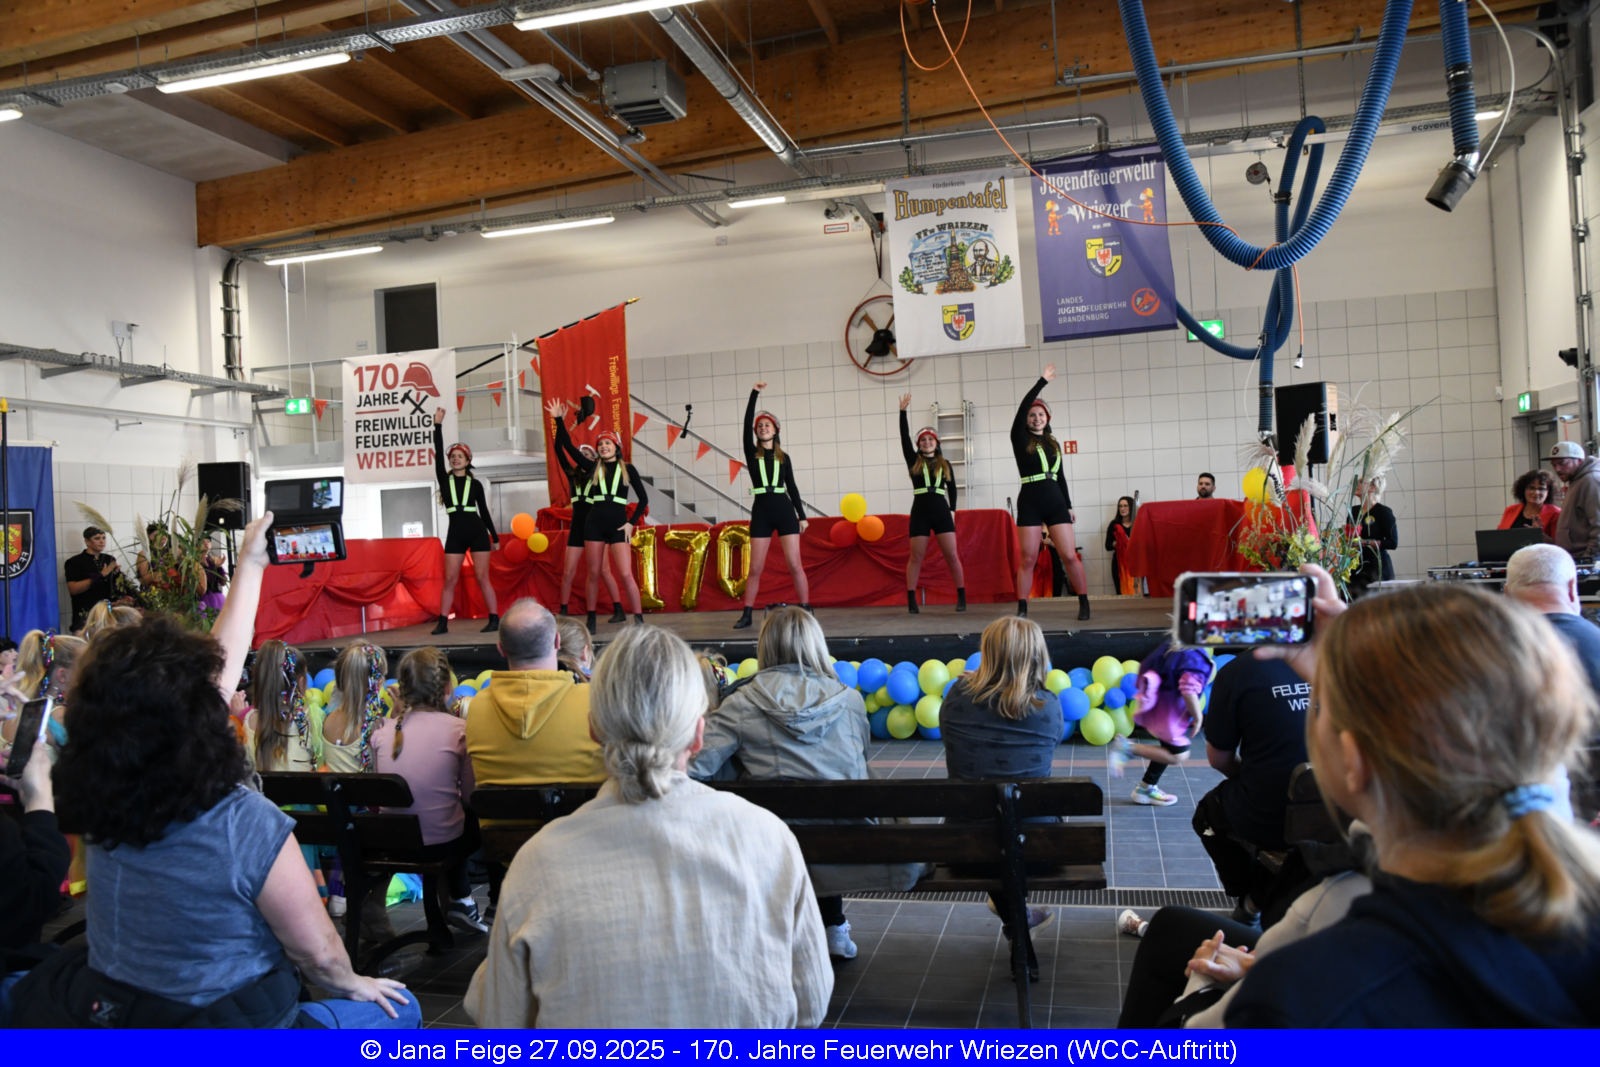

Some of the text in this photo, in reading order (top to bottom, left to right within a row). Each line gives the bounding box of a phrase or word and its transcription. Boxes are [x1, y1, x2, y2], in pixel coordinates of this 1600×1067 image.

[1411, 121, 1450, 132] ecovent
[1040, 156, 1157, 199] Jugendfeuerwehr
[893, 176, 1008, 221] Humpentafel
[1072, 200, 1129, 224] Wriezen
[936, 221, 989, 232] WRIEZEN
[1056, 296, 1084, 306] LANDES
[1057, 301, 1127, 315] JUGENDFEUERWEHR
[1058, 312, 1110, 324] BRANDENBURG
[353, 362, 399, 393] 170
[356, 392, 399, 408] JAHRE
[608, 355, 623, 433] Freiwillige Feuerwe
[355, 414, 435, 433] FREIWILLIG
[355, 430, 435, 450] FEUERWEH
[631, 525, 751, 610] 170
